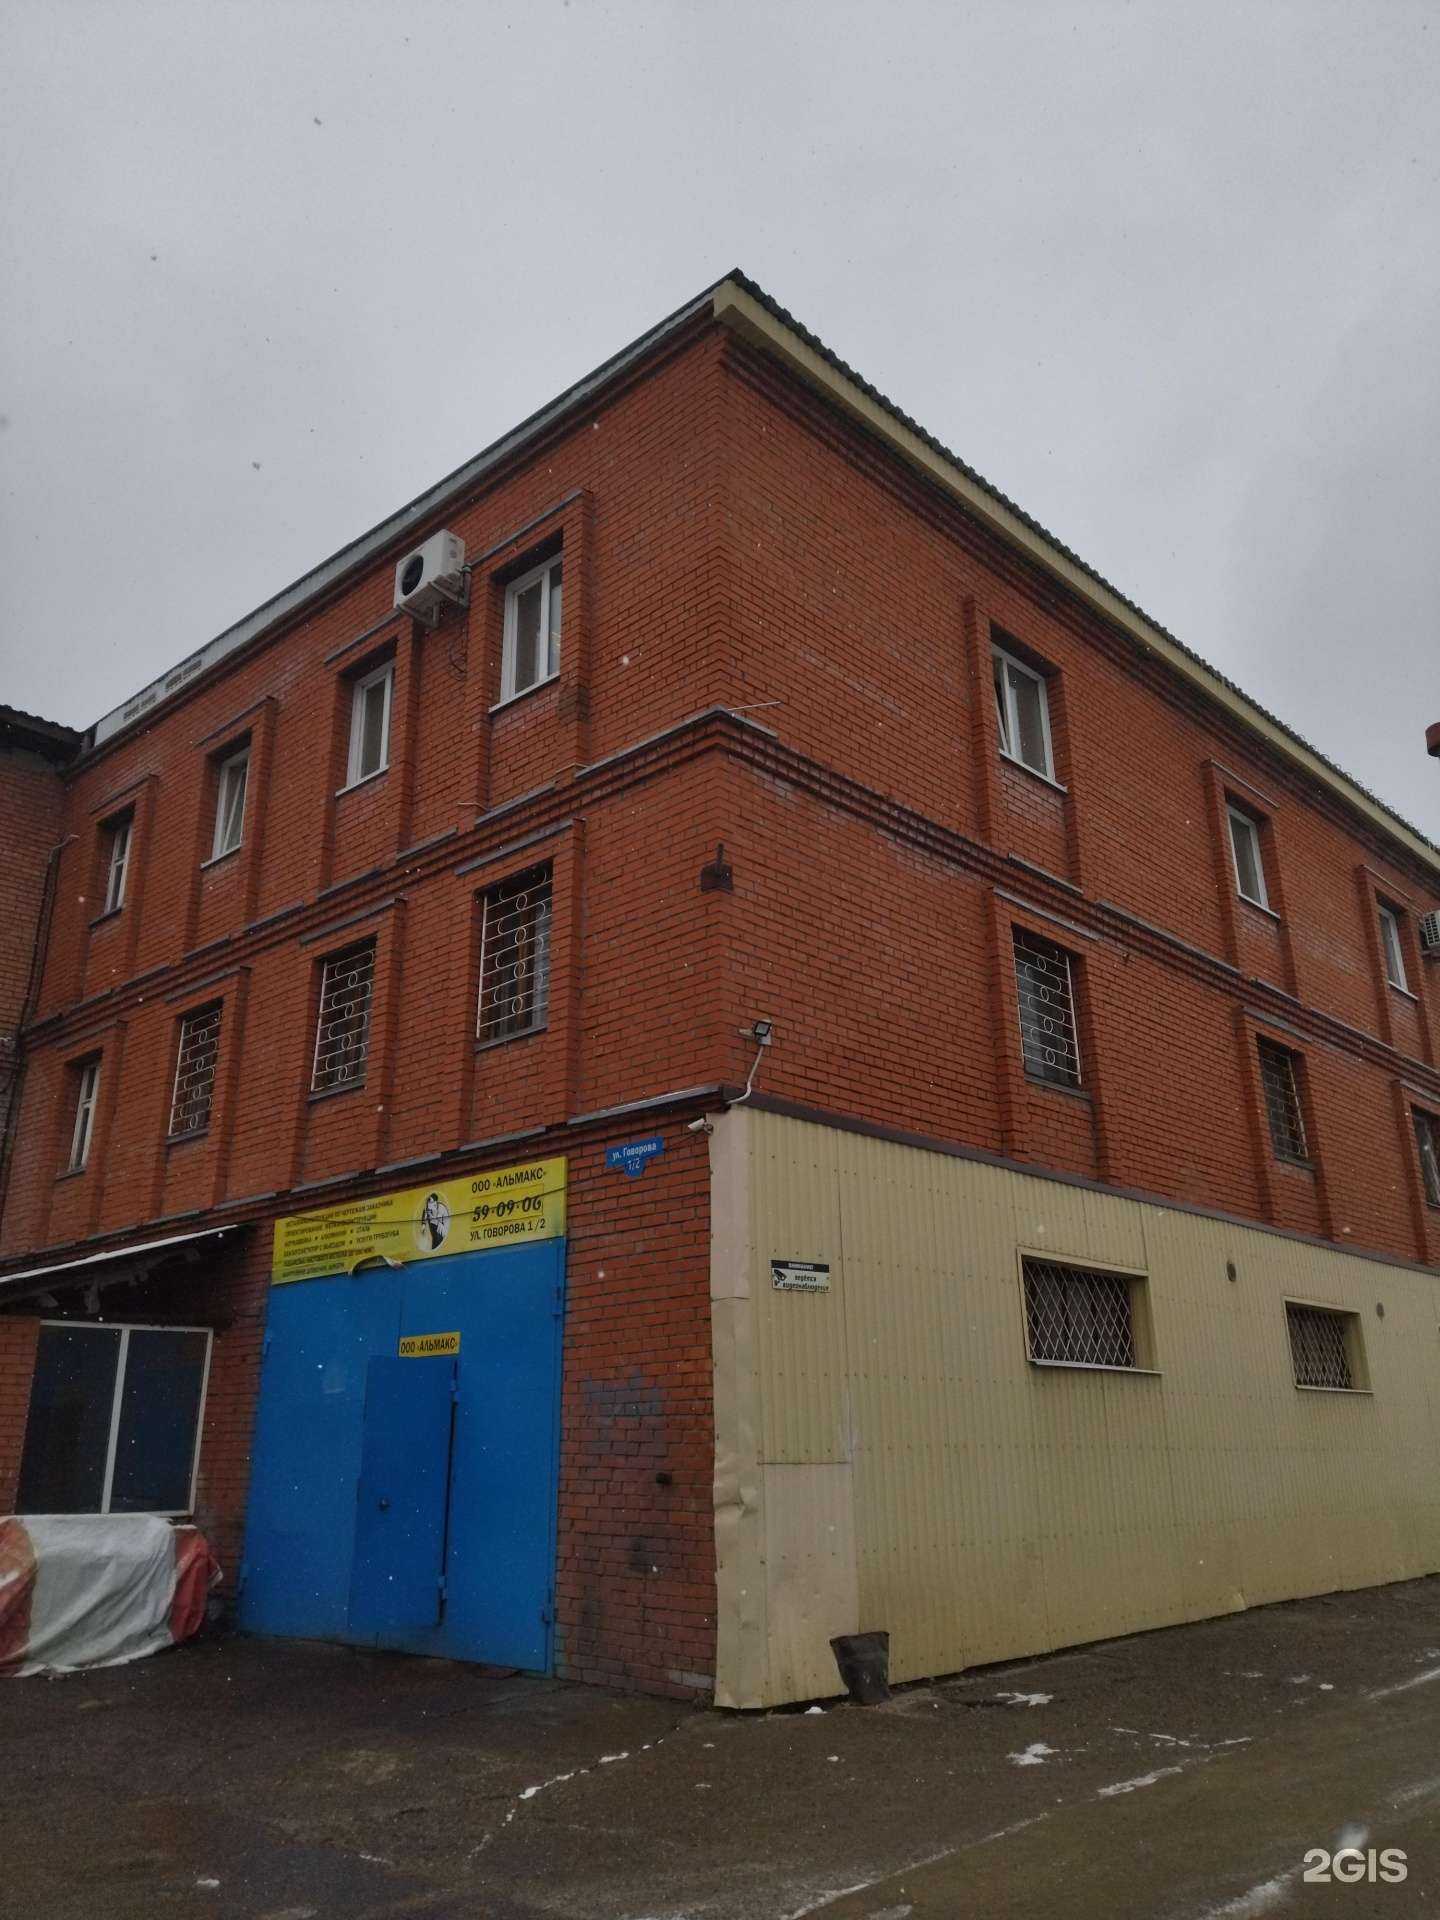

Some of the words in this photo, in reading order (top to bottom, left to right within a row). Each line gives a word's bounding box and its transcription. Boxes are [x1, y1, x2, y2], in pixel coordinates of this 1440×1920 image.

[623, 1142, 657, 1157] Говорова
[471, 1179, 490, 1193] ООО
[483, 1223, 525, 1239] ГОВОРОВА
[400, 1341, 416, 1354] ООО
